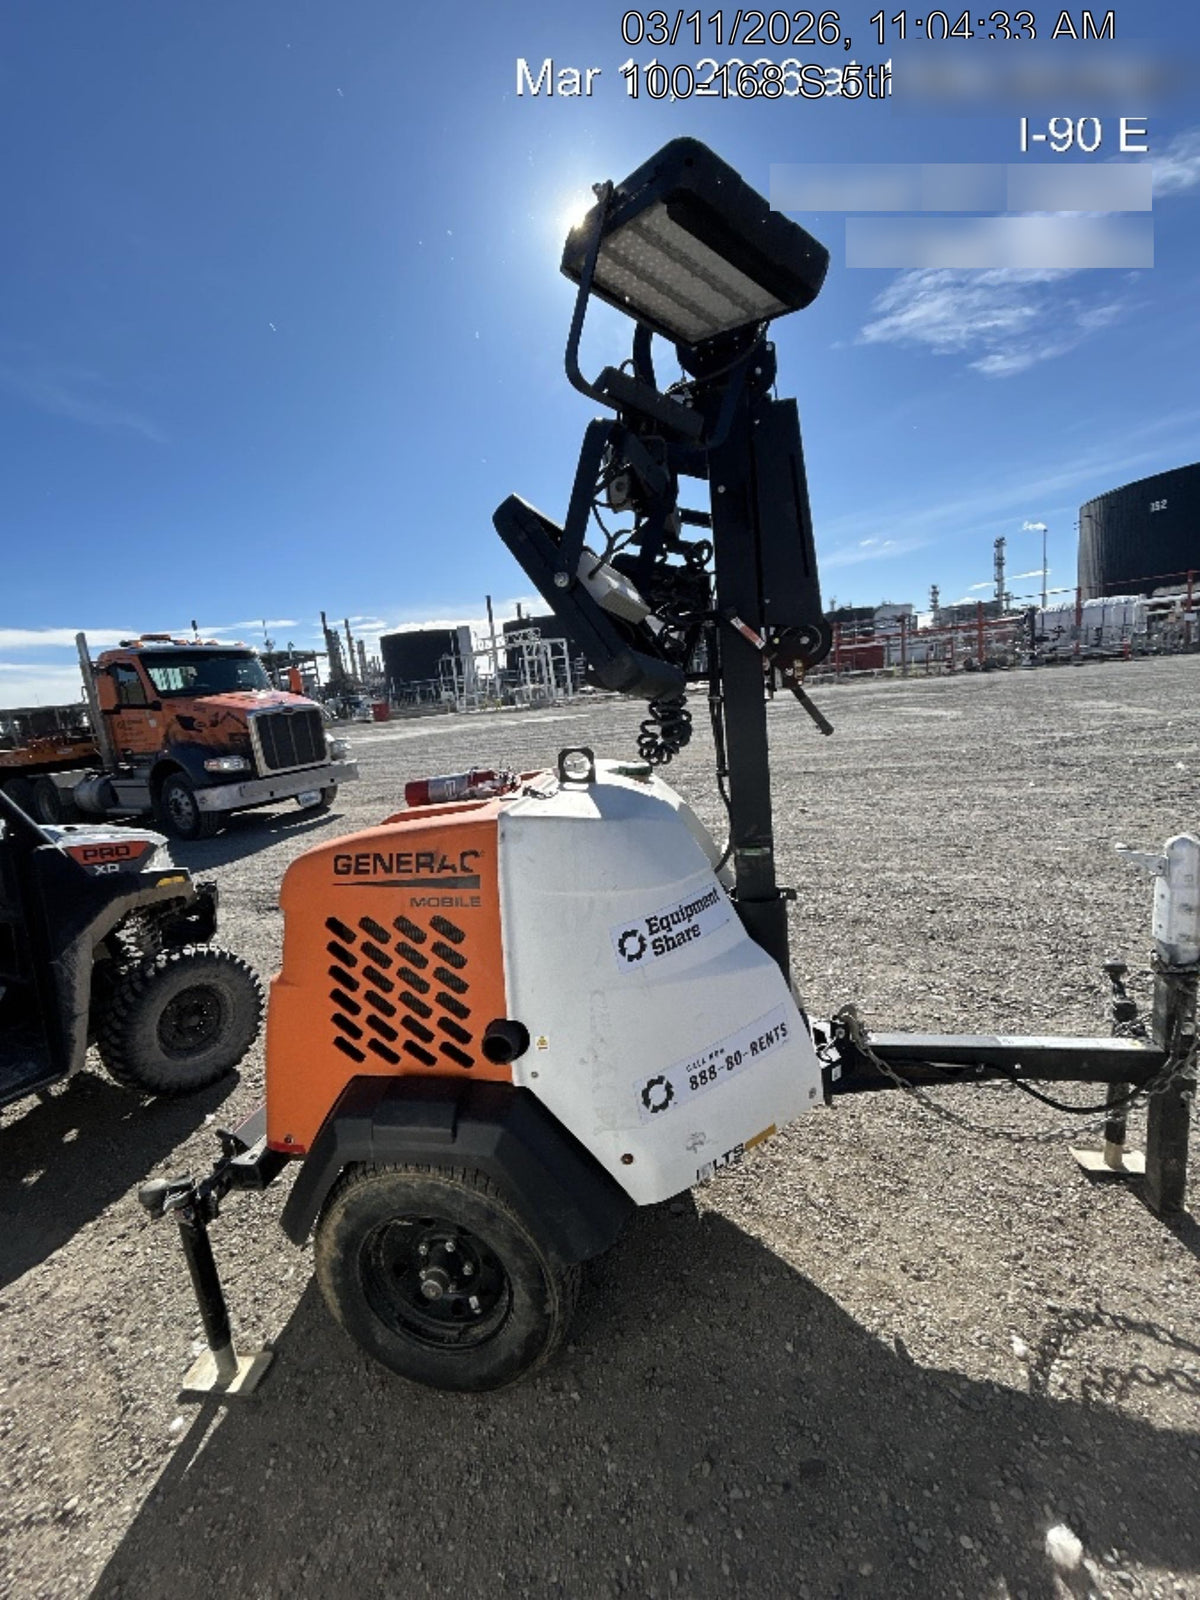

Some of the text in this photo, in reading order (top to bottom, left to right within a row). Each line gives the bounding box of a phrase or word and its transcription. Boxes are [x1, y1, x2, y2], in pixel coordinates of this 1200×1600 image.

[83, 845, 131, 861] PRO
[333, 850, 481, 876] GENERAC
[410, 896, 482, 908] MOBILE
[645, 887, 720, 936] Equipment
[651, 924, 701, 957] Share
[689, 1022, 788, 1090] 888-80-RENTS
